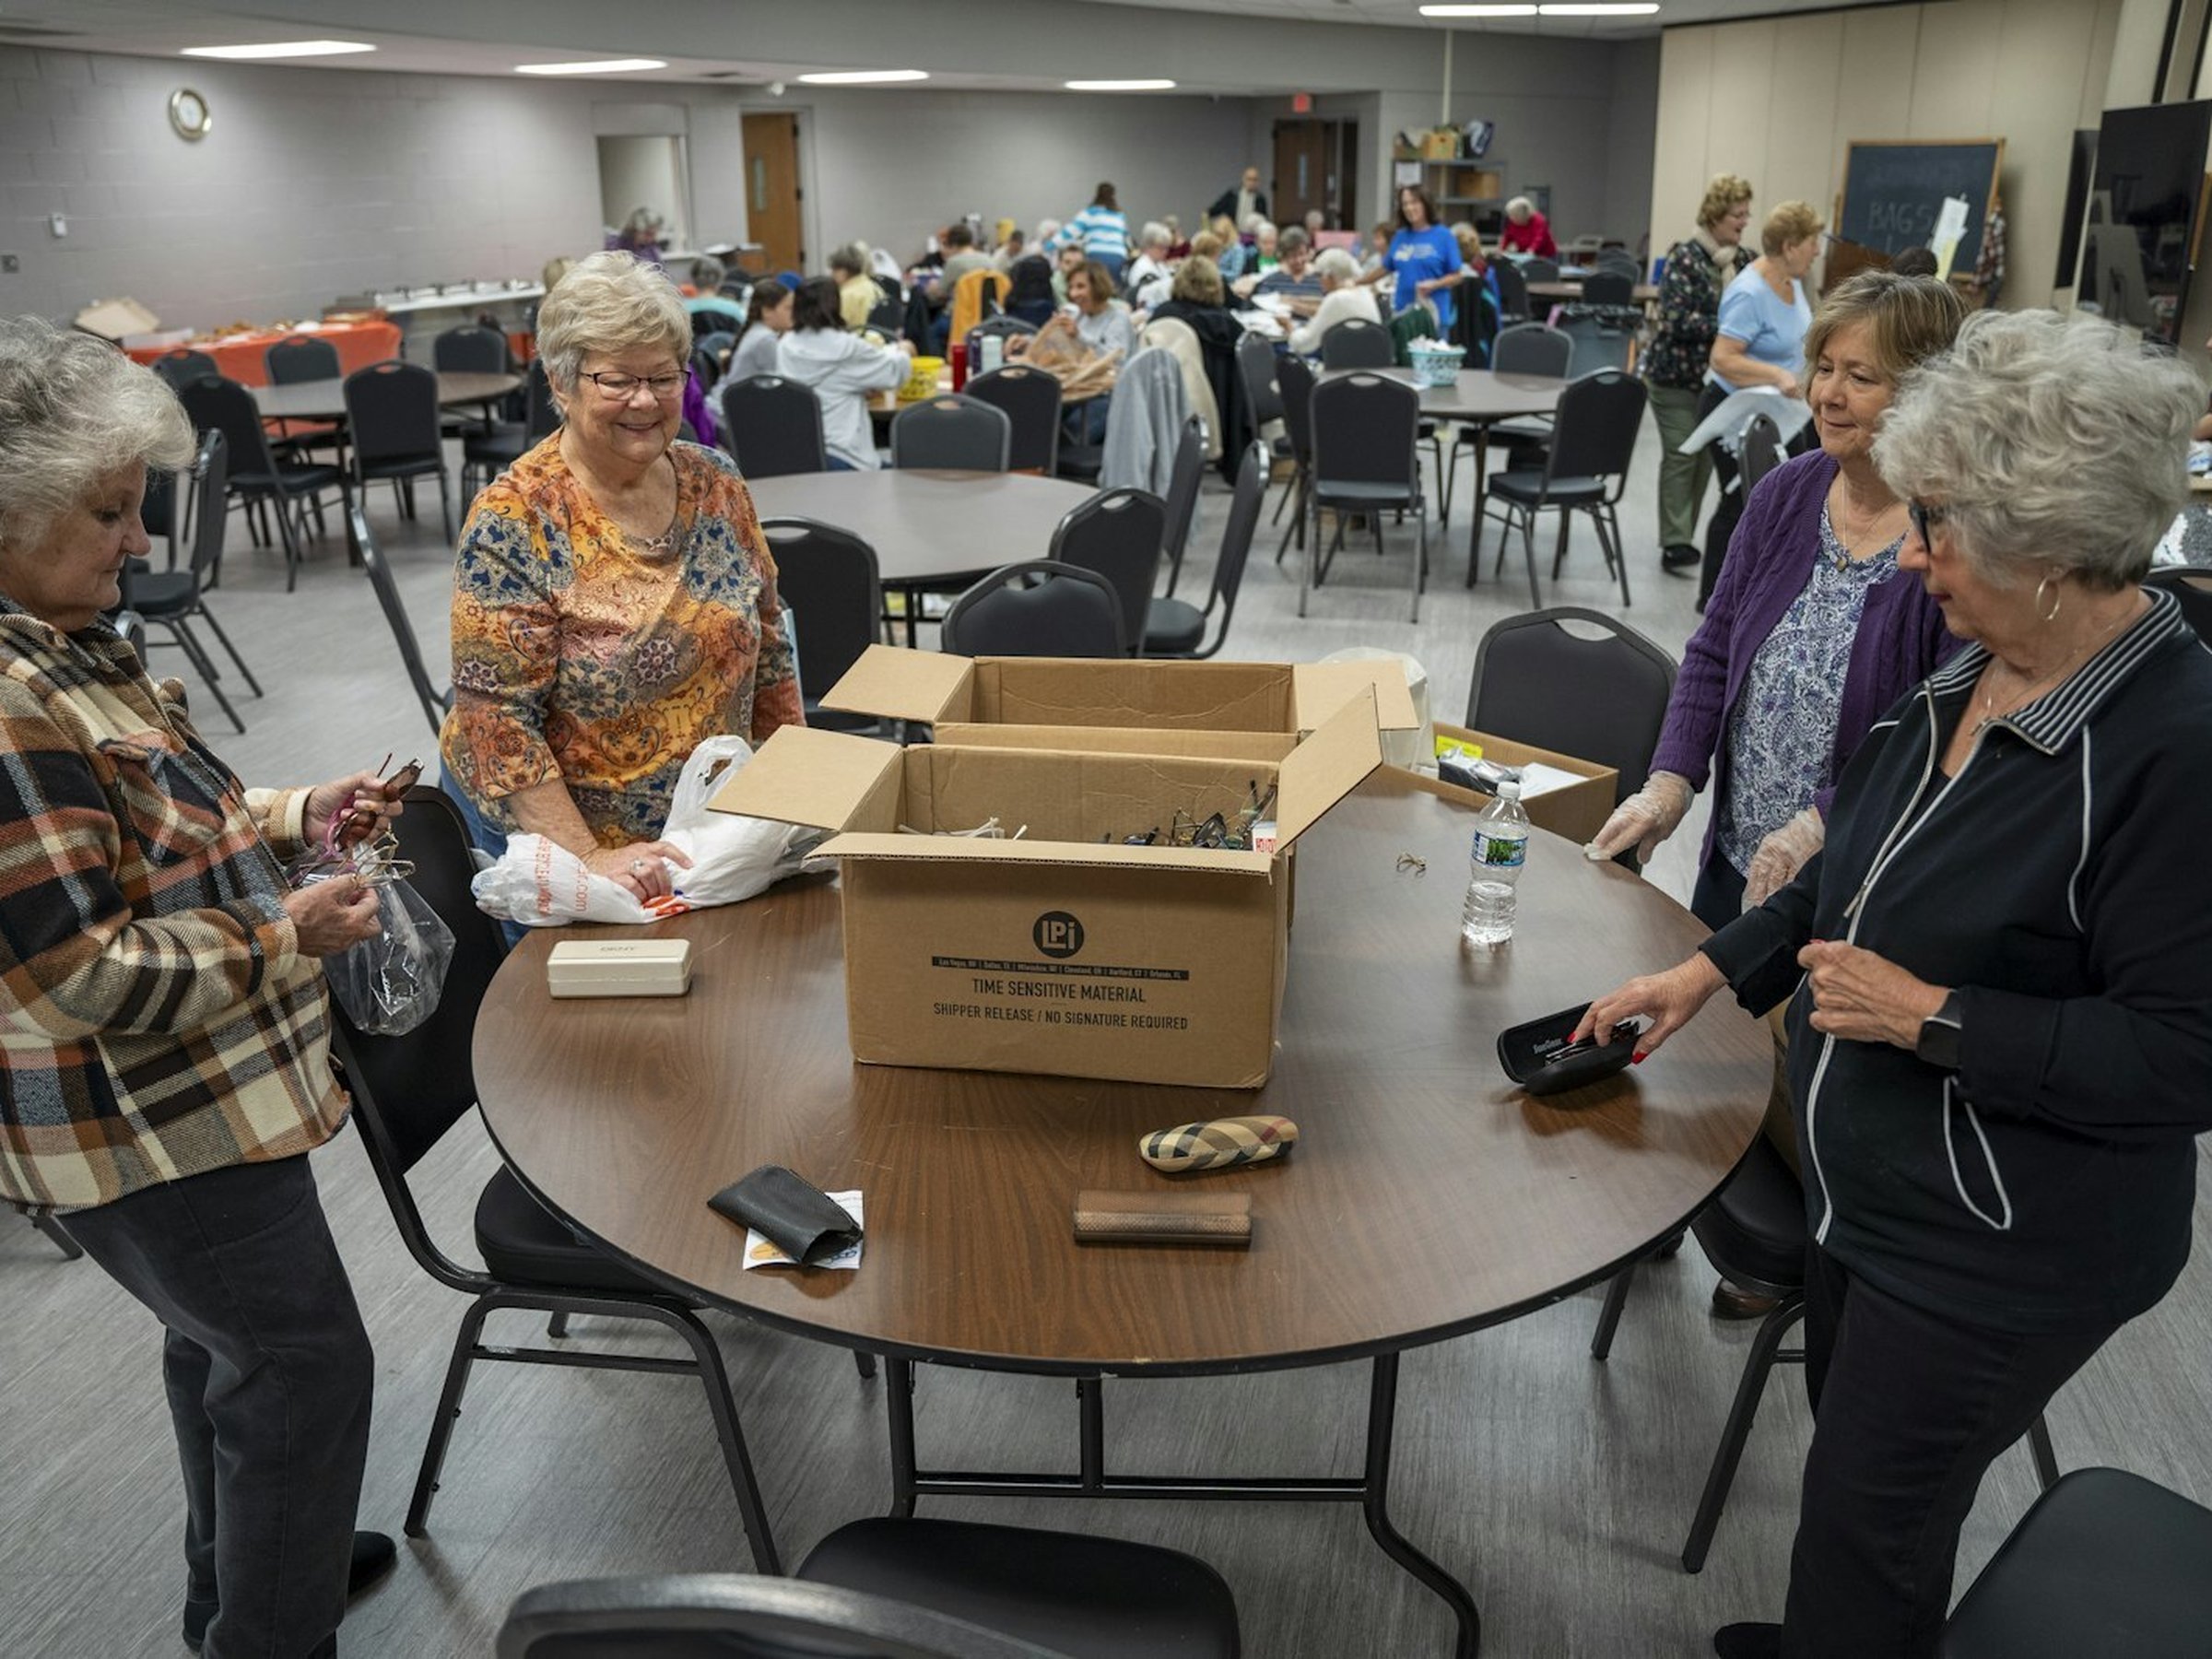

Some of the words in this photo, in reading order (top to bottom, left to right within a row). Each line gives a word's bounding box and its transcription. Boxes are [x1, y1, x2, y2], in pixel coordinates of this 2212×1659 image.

[1867, 201, 1934, 234] BAGS
[973, 979, 1004, 994] TIME
[1008, 981, 1077, 999] SENSITIVE
[1081, 984, 1147, 1003] MATERIAL
[934, 1002, 982, 1018] SHIPPER
[984, 1006, 1034, 1022] RELEASE
[1045, 1010, 1062, 1024] NO
[1065, 1011, 1127, 1027] SIGNATURE
[1131, 1015, 1188, 1030] REQUIRED
